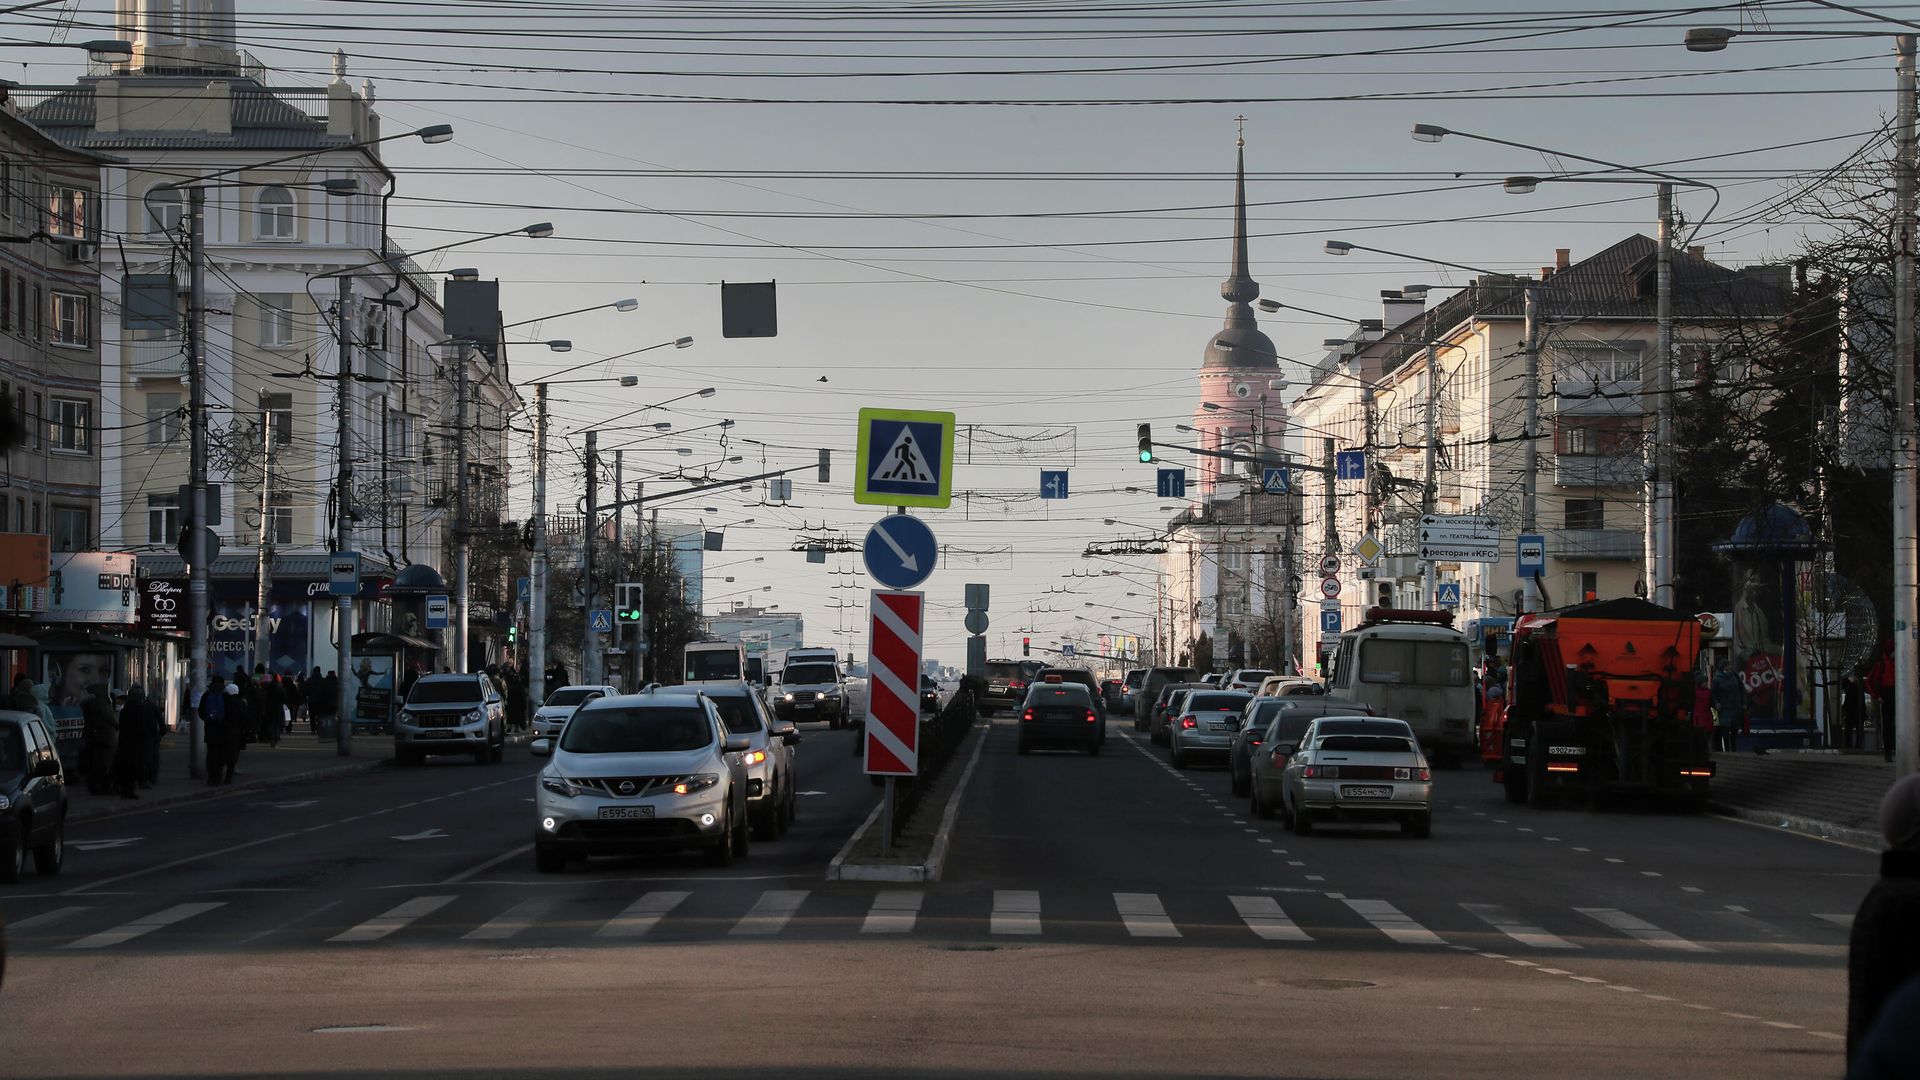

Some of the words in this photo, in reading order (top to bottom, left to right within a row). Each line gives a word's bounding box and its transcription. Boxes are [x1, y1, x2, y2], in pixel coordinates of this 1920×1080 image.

[1429, 549, 1469, 558] ресторан
[1471, 550, 1498, 558] «KFC»
[1326, 613, 1338, 629] P
[602, 808, 639, 818] Е595СЕ
